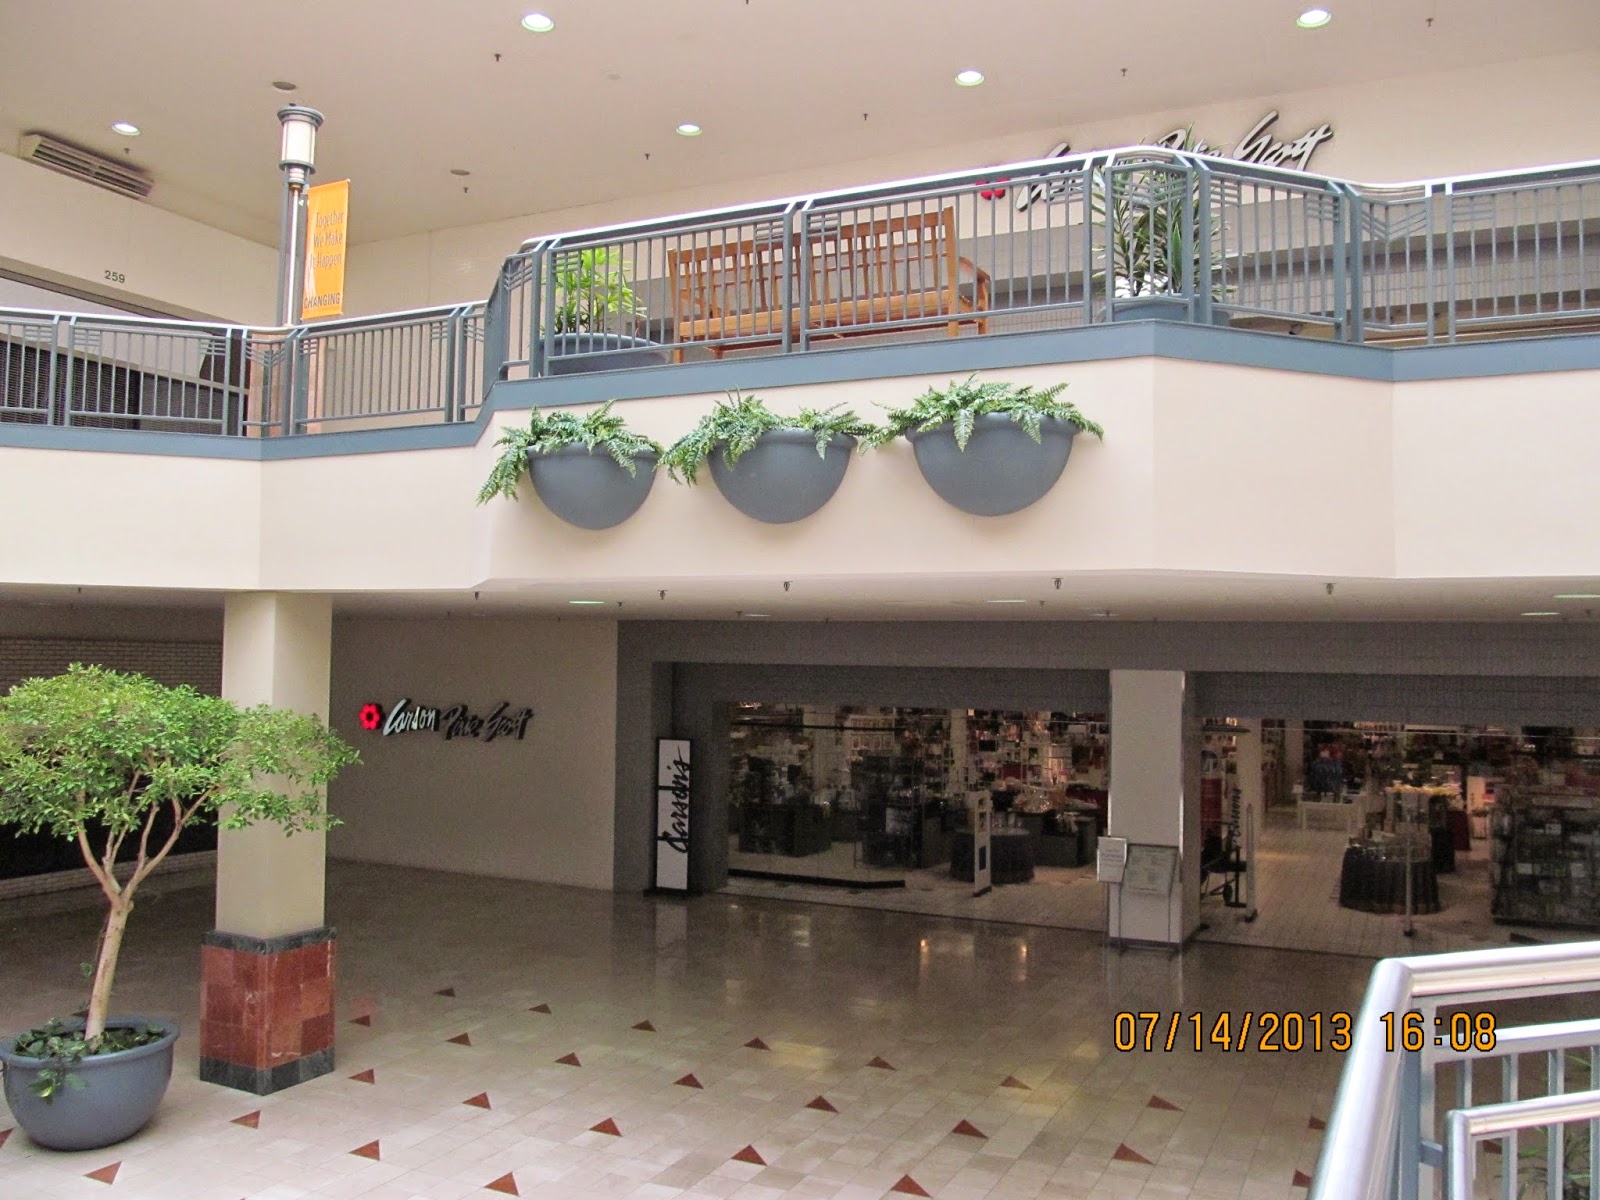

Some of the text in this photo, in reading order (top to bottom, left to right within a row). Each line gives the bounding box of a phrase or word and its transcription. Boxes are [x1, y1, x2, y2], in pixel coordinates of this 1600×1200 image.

[315, 211, 344, 230] Together
[313, 231, 343, 248] We Make
[317, 252, 342, 270] Happen
[104, 270, 125, 283] 259
[303, 292, 341, 309] CHANGING
[383, 698, 439, 736] Carson
[484, 702, 534, 742] Scott
[661, 745, 690, 854] Carson's
